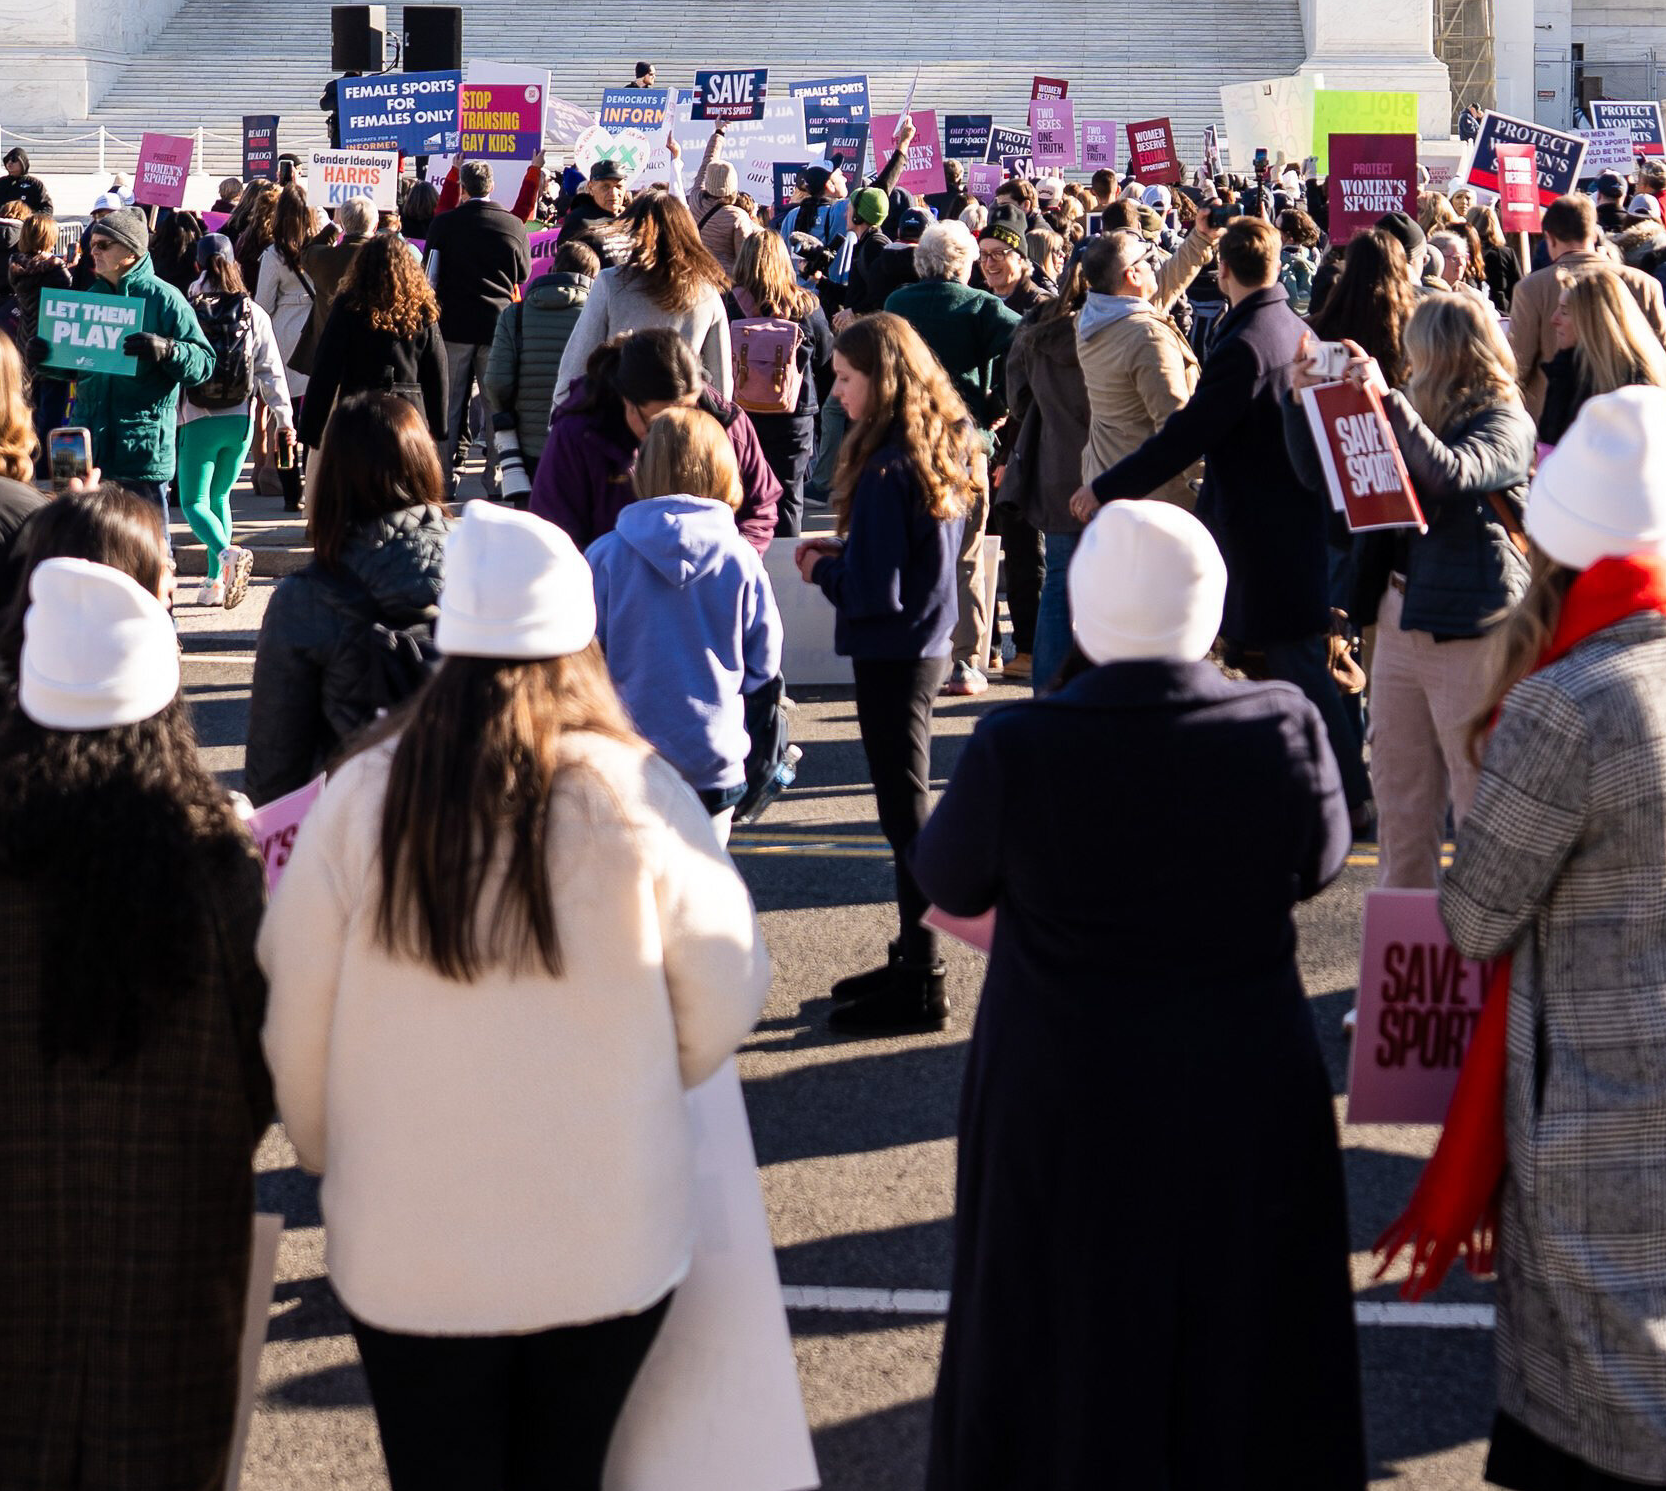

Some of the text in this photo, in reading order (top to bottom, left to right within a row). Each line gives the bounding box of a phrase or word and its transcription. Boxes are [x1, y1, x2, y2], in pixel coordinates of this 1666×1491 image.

[345, 79, 456, 100] FEMALE SPORTS
[707, 73, 756, 104] SAVE
[794, 82, 865, 99] FEMALE SPORTS
[1038, 84, 1063, 95] WOMEN
[386, 97, 417, 111] FOR
[462, 90, 493, 110] STOP
[606, 95, 659, 105] DEMOCRATS
[821, 96, 841, 107] FOR
[603, 108, 667, 124] INFORM
[733, 106, 753, 115] SPORTS
[1036, 108, 1054, 119] TWO
[1600, 105, 1653, 117] PROTECT
[350, 109, 455, 129] FEMALES ONLY
[462, 111, 521, 131] TRANSING
[809, 117, 824, 125] our
[1036, 119, 1065, 130] SEXES.
[247, 128, 272, 138] REALITY
[965, 127, 989, 137] sports
[1037, 132, 1054, 142] ONE
[1086, 125, 1103, 135] TWO
[1134, 127, 1165, 143] WOMEN
[1494, 119, 1575, 156] PROTECT
[461, 132, 486, 153] GAY
[488, 134, 517, 153] KIDS
[832, 137, 860, 147] REALITY
[963, 136, 989, 147] spaces
[998, 130, 1032, 146] PROTE
[1136, 138, 1167, 153] DESERVE
[1037, 143, 1067, 154] TRUTH.
[1086, 144, 1100, 153] ONE
[1489, 136, 1570, 173] WEN'S
[152, 152, 177, 163] PROTECT
[313, 153, 393, 169] Gender Ideology
[1138, 149, 1169, 165] EQUAL
[1614, 155, 1632, 163] LAND
[144, 162, 184, 178] WOMEN'S
[1140, 161, 1171, 173] OPPORTUNITY
[1353, 163, 1394, 175] PROTECT
[142, 172, 180, 187] SPORTS
[324, 166, 380, 185] HARMS
[973, 172, 987, 182] TWO
[1339, 179, 1408, 196] WOMEN'S
[1343, 195, 1404, 212] SPORTS
[45, 299, 137, 325] LET THEM
[52, 319, 124, 350] PLAY
[1382, 941, 1468, 1006] SAVE
